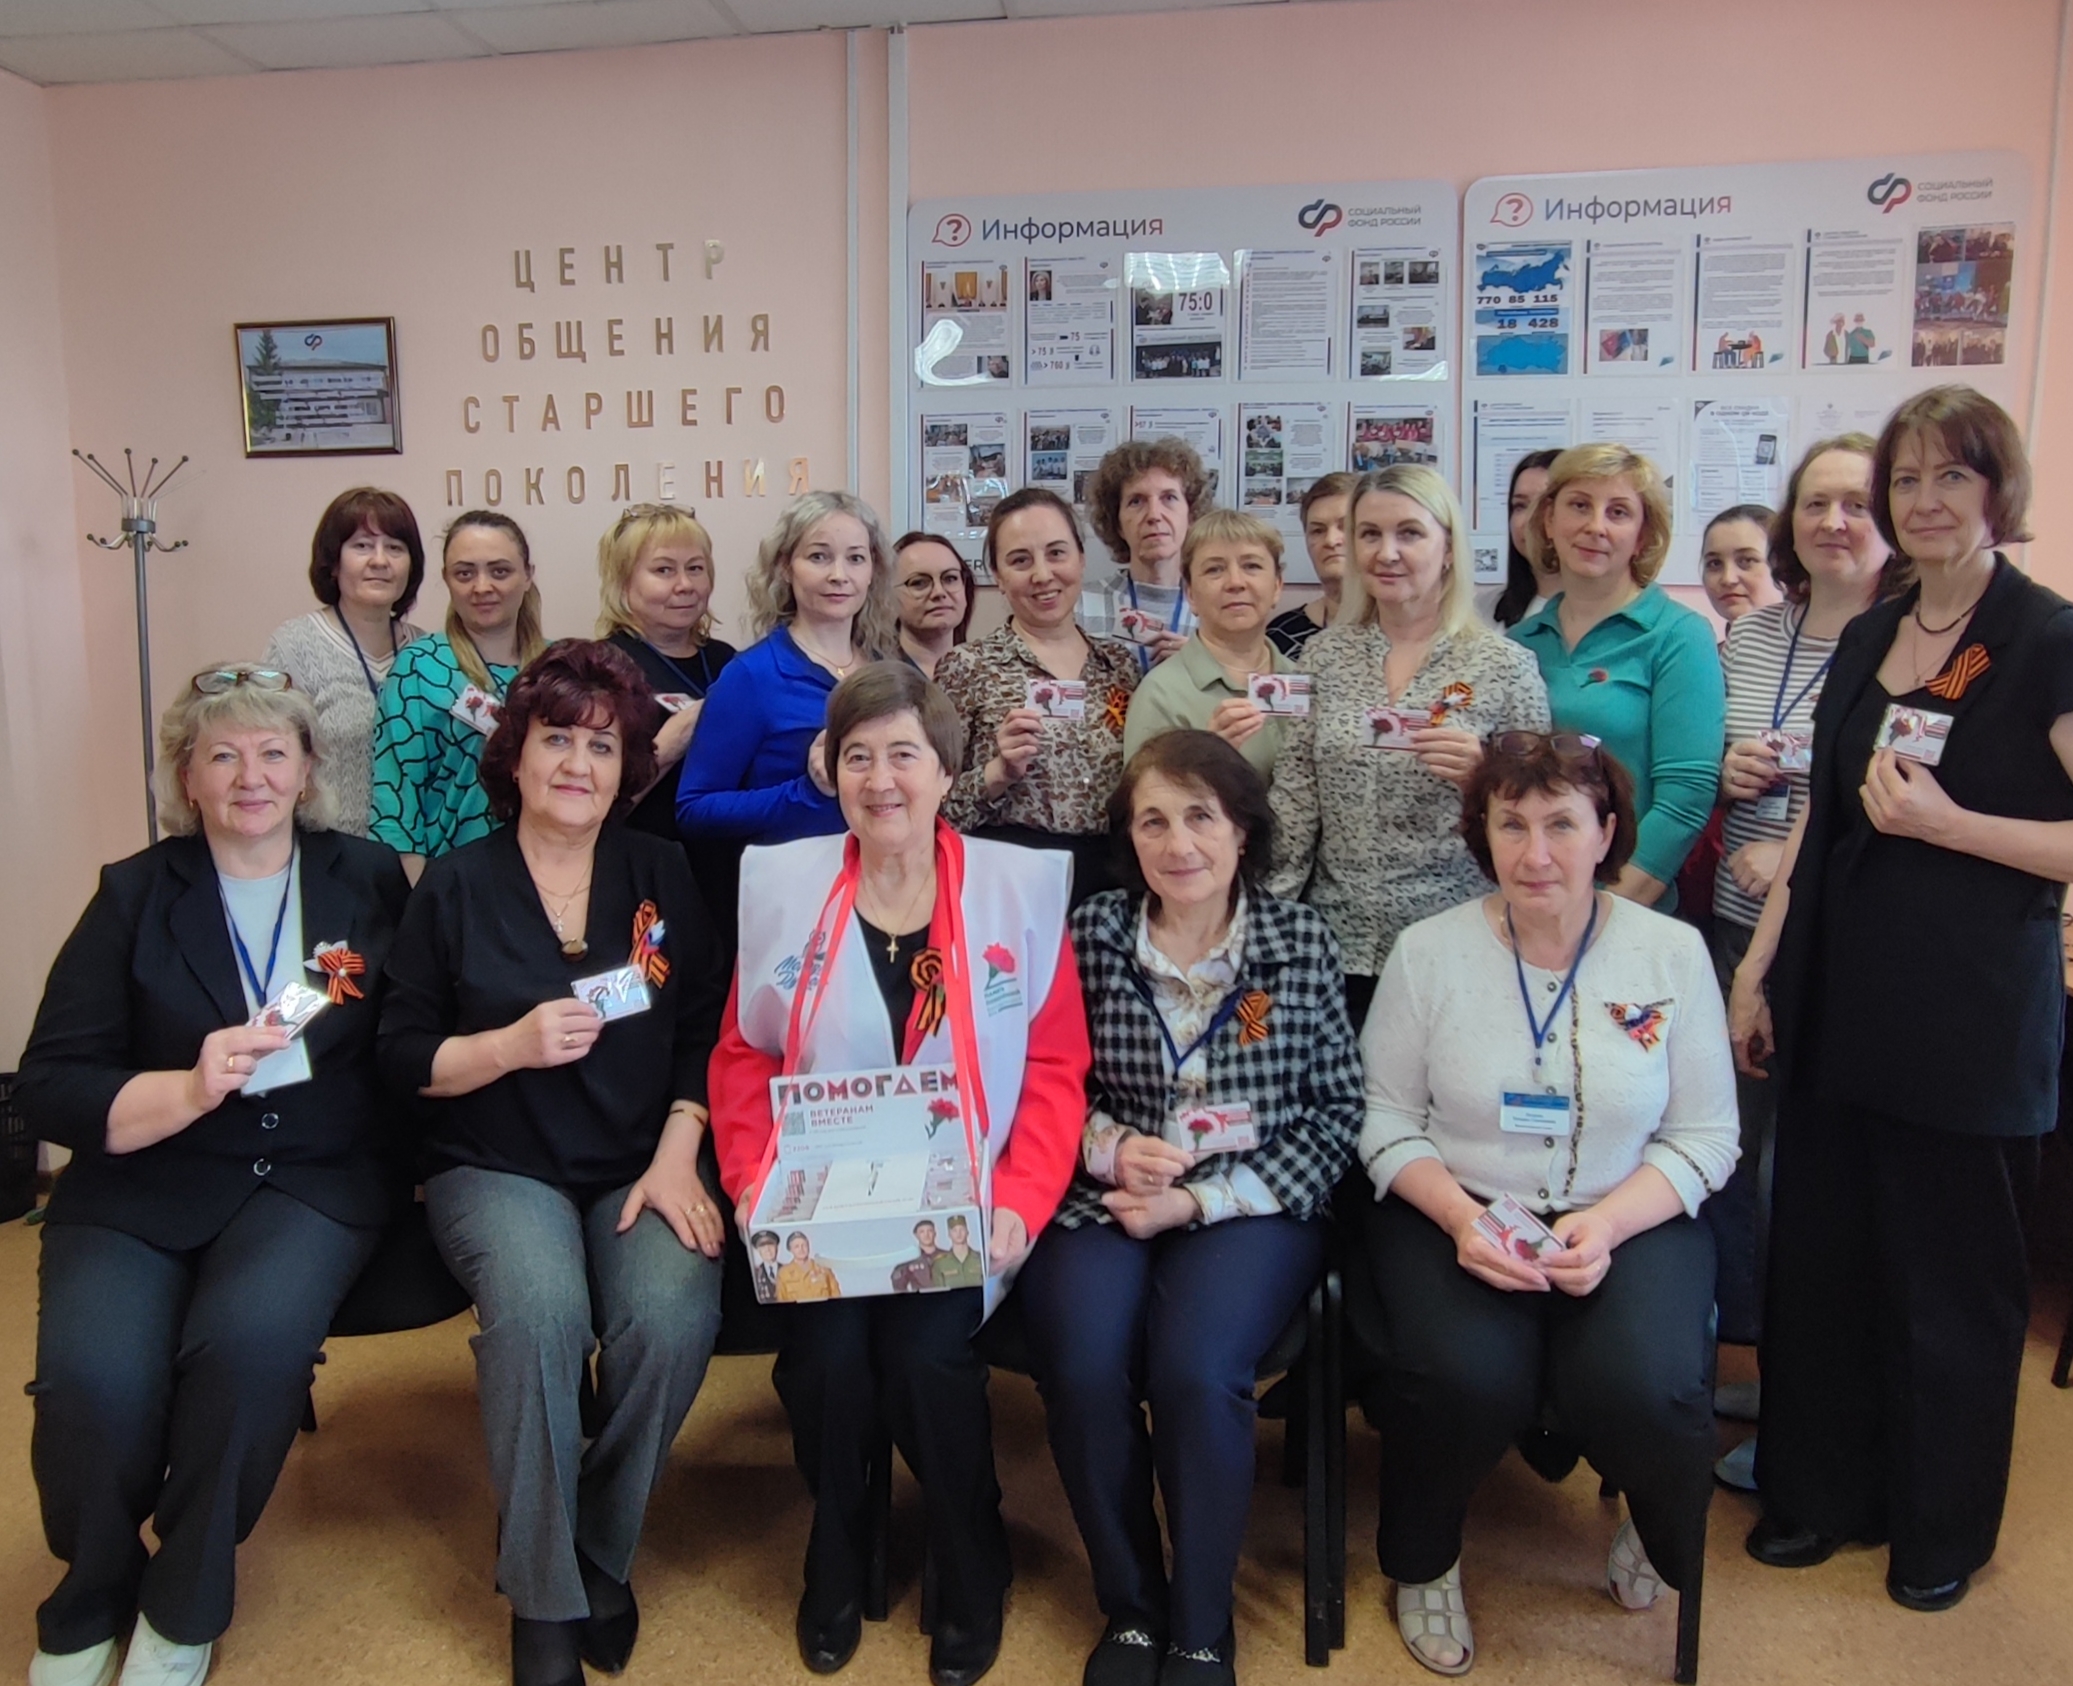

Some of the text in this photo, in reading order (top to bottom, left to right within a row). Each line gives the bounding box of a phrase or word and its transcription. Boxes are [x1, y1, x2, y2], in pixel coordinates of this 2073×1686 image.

[1917, 177, 1993, 191] СОЦИАЛЬНЫЙ
[1916, 190, 1992, 203] ФОНД РОССИИ
[1347, 205, 1421, 216] СОЦИАЛЬНЫЙ
[1545, 195, 1732, 225] Информация
[1347, 217, 1421, 227] ФОНД РОССИИ
[982, 216, 1163, 245] Информация
[514, 239, 725, 293] ЦЕНТР
[1178, 291, 1213, 311] 75:0
[1476, 294, 1558, 304] 770 85 115
[1527, 317, 1559, 328] 428
[481, 313, 770, 363] ОБЩЕНИЯ
[463, 384, 786, 434] СТАРШЕГО
[445, 457, 810, 506] ПОКОЛЕНИЯ
[810, 1104, 874, 1118] ВЕТЕРАНАМ
[810, 1116, 854, 1128] ВМЕСТЕ
